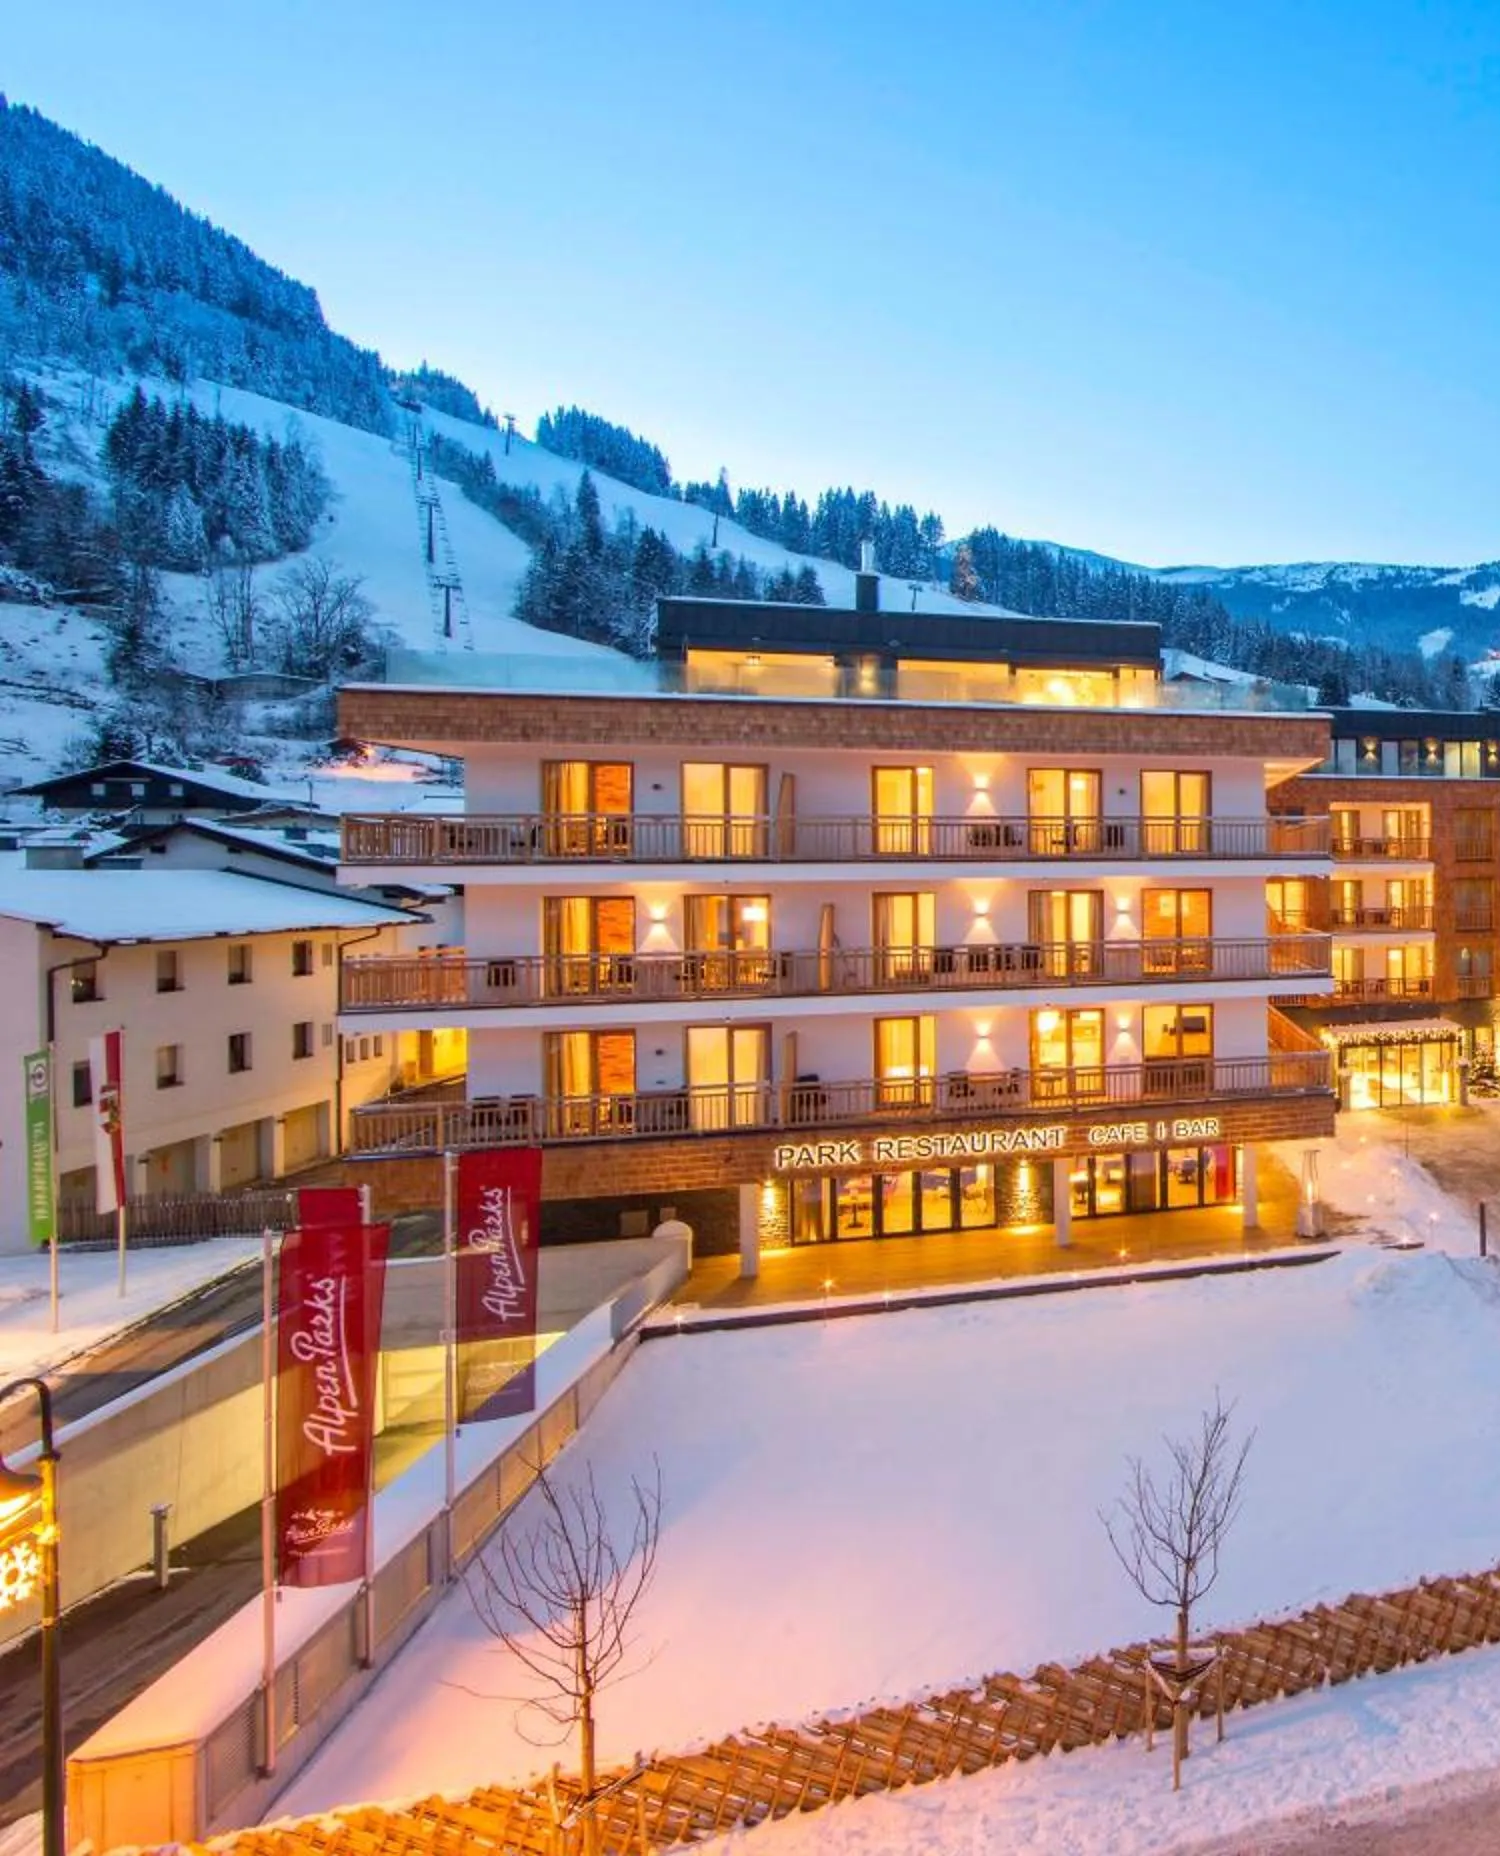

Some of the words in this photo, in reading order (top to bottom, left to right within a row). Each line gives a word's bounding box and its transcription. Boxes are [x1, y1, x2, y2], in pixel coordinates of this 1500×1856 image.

[776, 1142, 860, 1169] PARK
[876, 1126, 1066, 1161] RESTAURANT
[1088, 1122, 1149, 1145] CAFE
[1173, 1117, 1219, 1140] BAR
